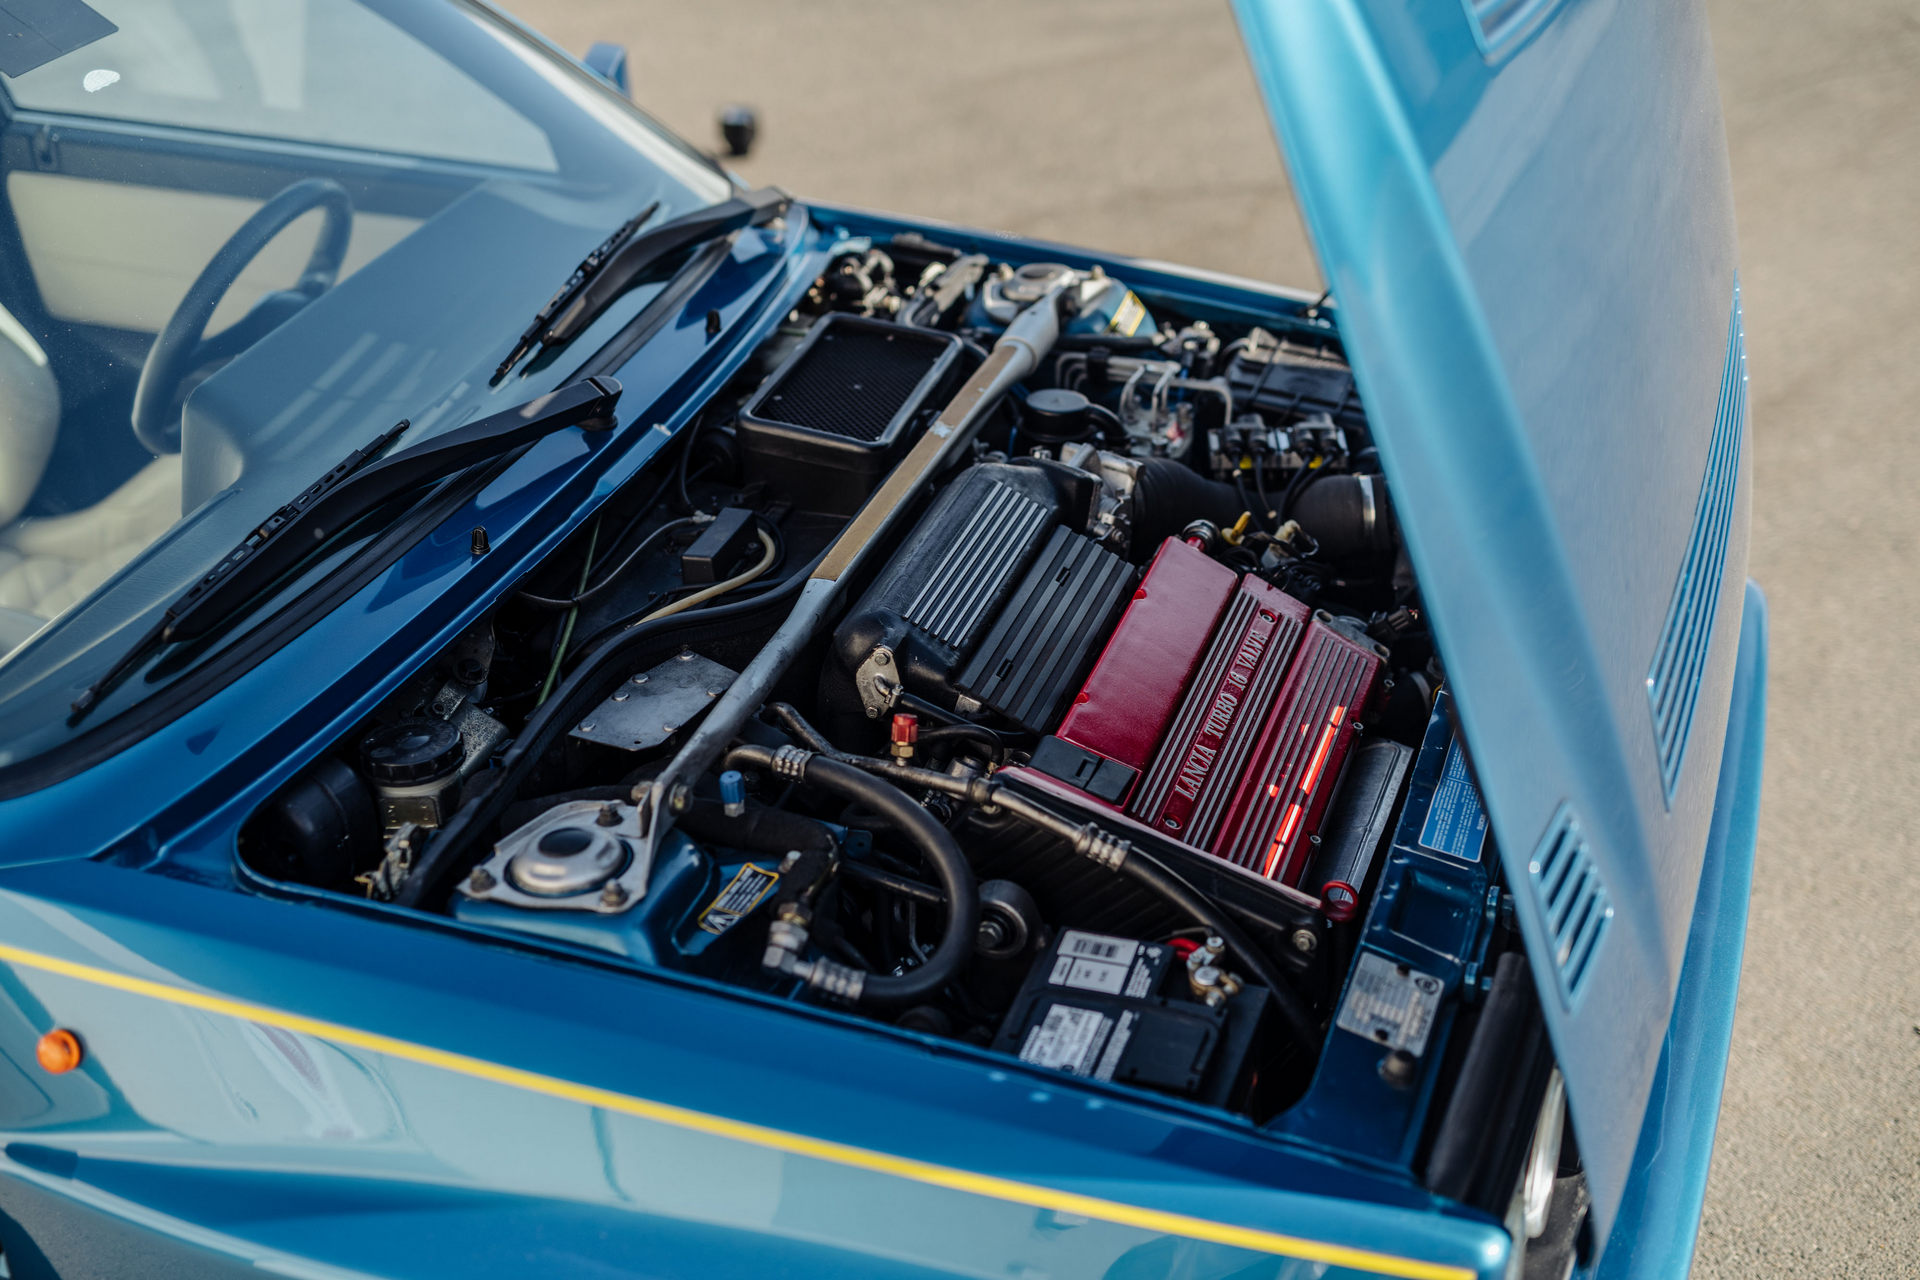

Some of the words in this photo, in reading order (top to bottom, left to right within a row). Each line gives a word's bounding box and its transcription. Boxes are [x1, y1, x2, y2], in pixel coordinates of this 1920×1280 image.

[1236, 630, 1269, 671] VALVE
[1228, 671, 1249, 691] 16
[1204, 693, 1239, 740] TURBO
[1175, 744, 1217, 801] LANCIA
